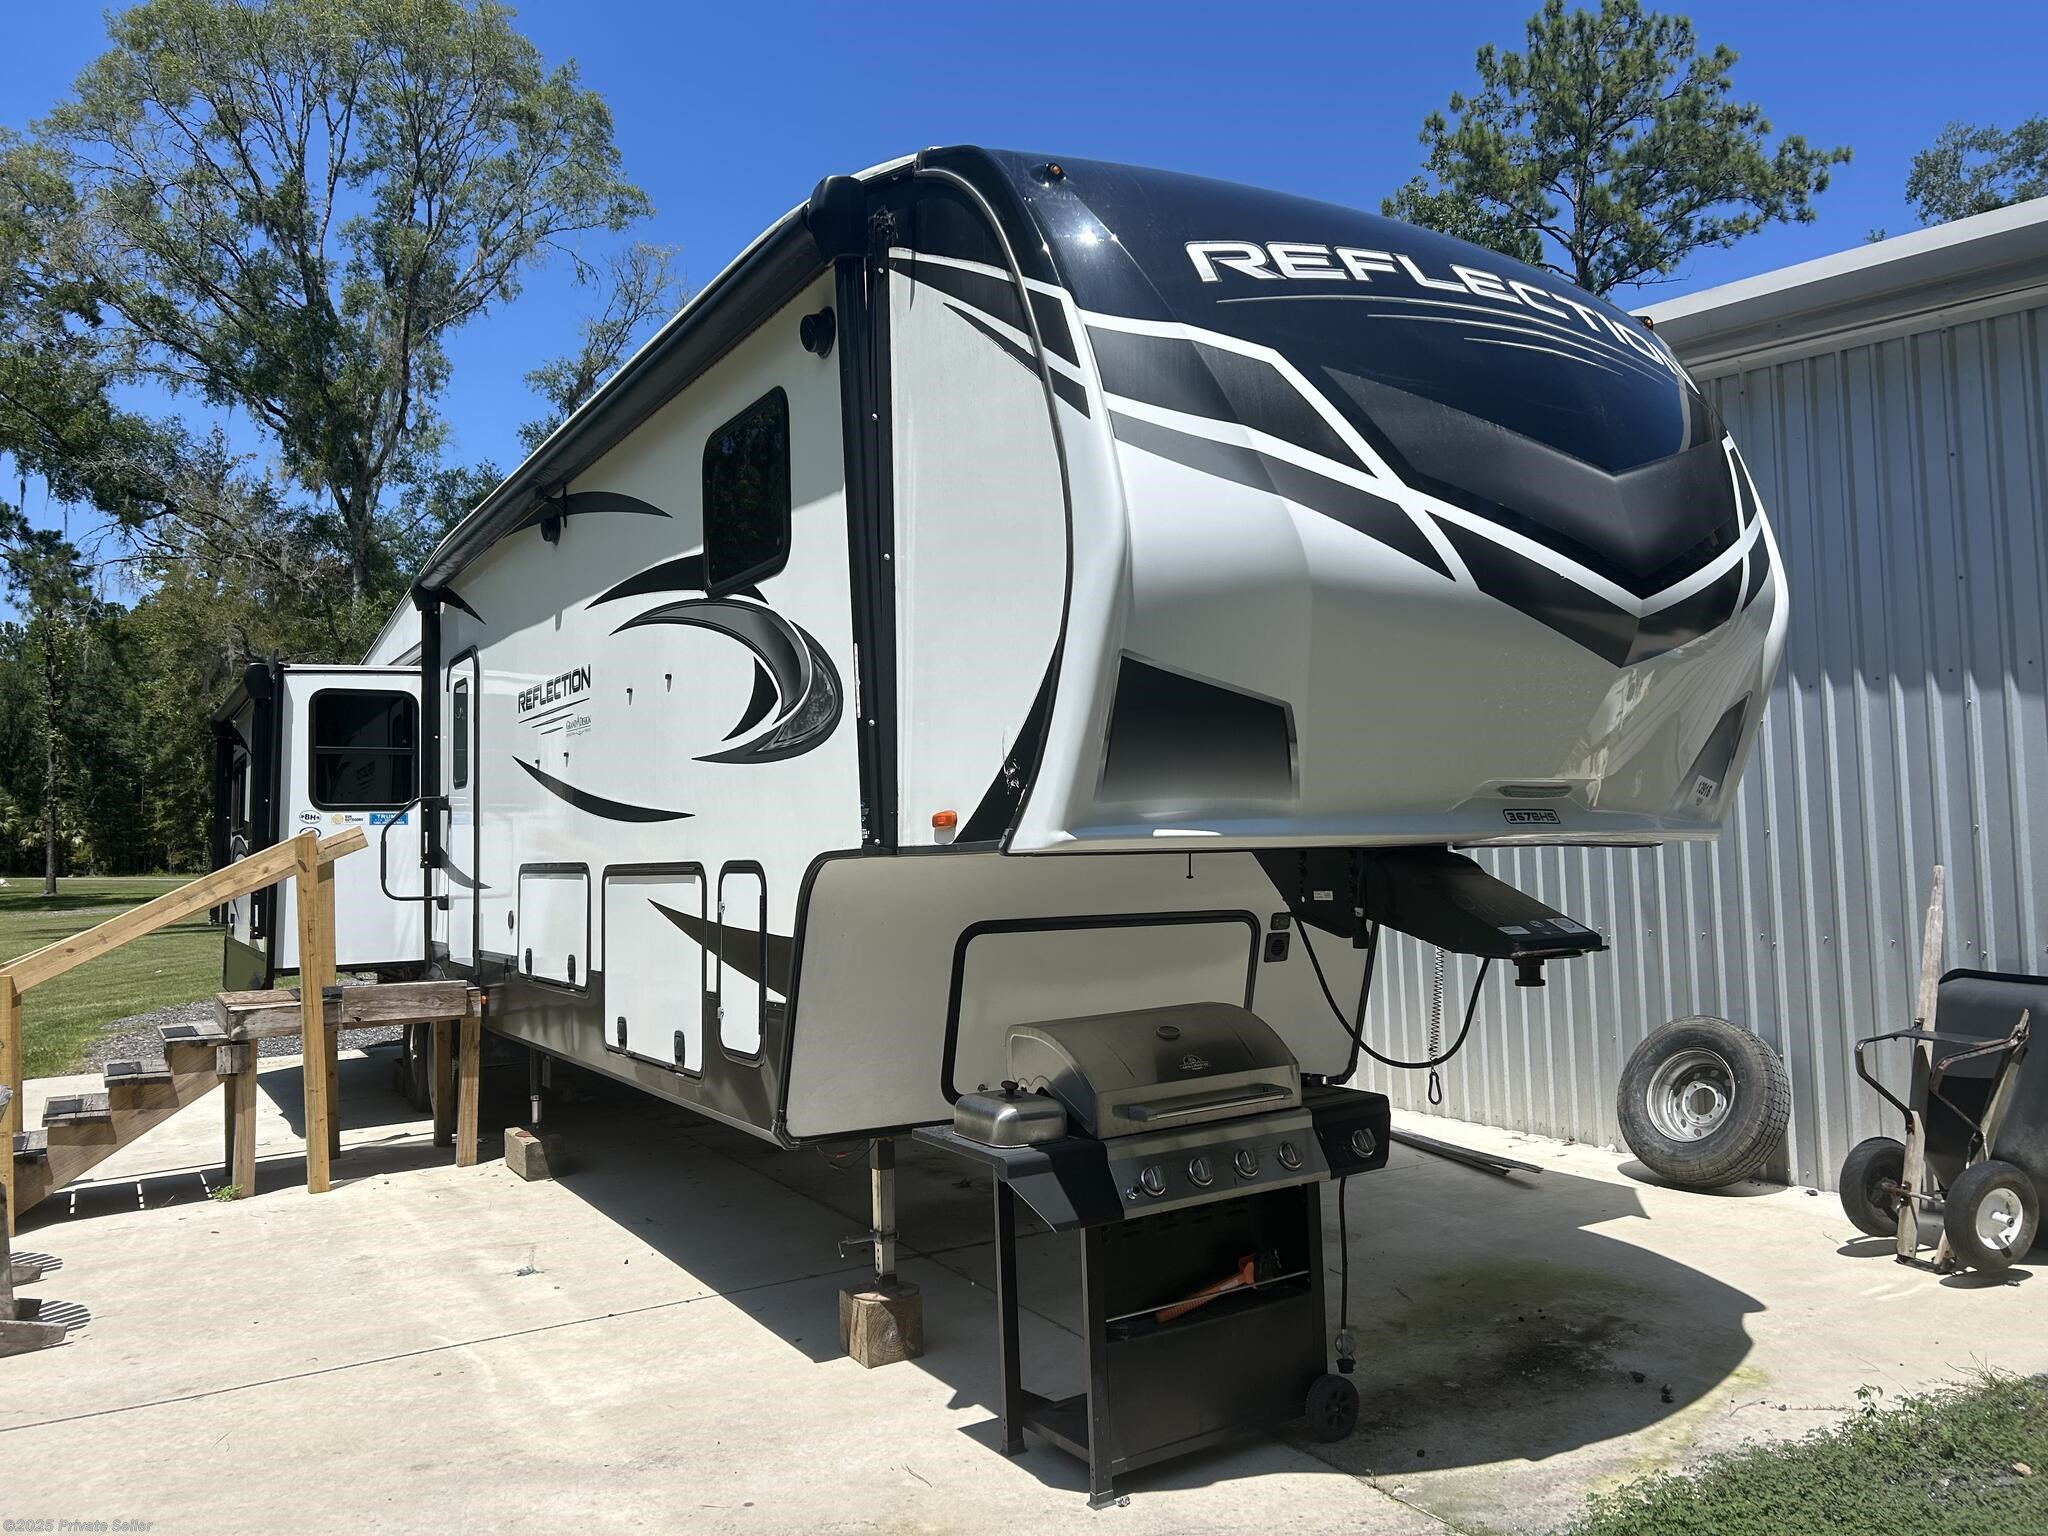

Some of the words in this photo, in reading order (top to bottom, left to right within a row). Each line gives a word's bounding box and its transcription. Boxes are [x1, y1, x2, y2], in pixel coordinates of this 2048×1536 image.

[1184, 240, 1700, 395] REFLECTION
[518, 664, 591, 714] REFLECTION
[1506, 812, 1556, 822] 367BHS
